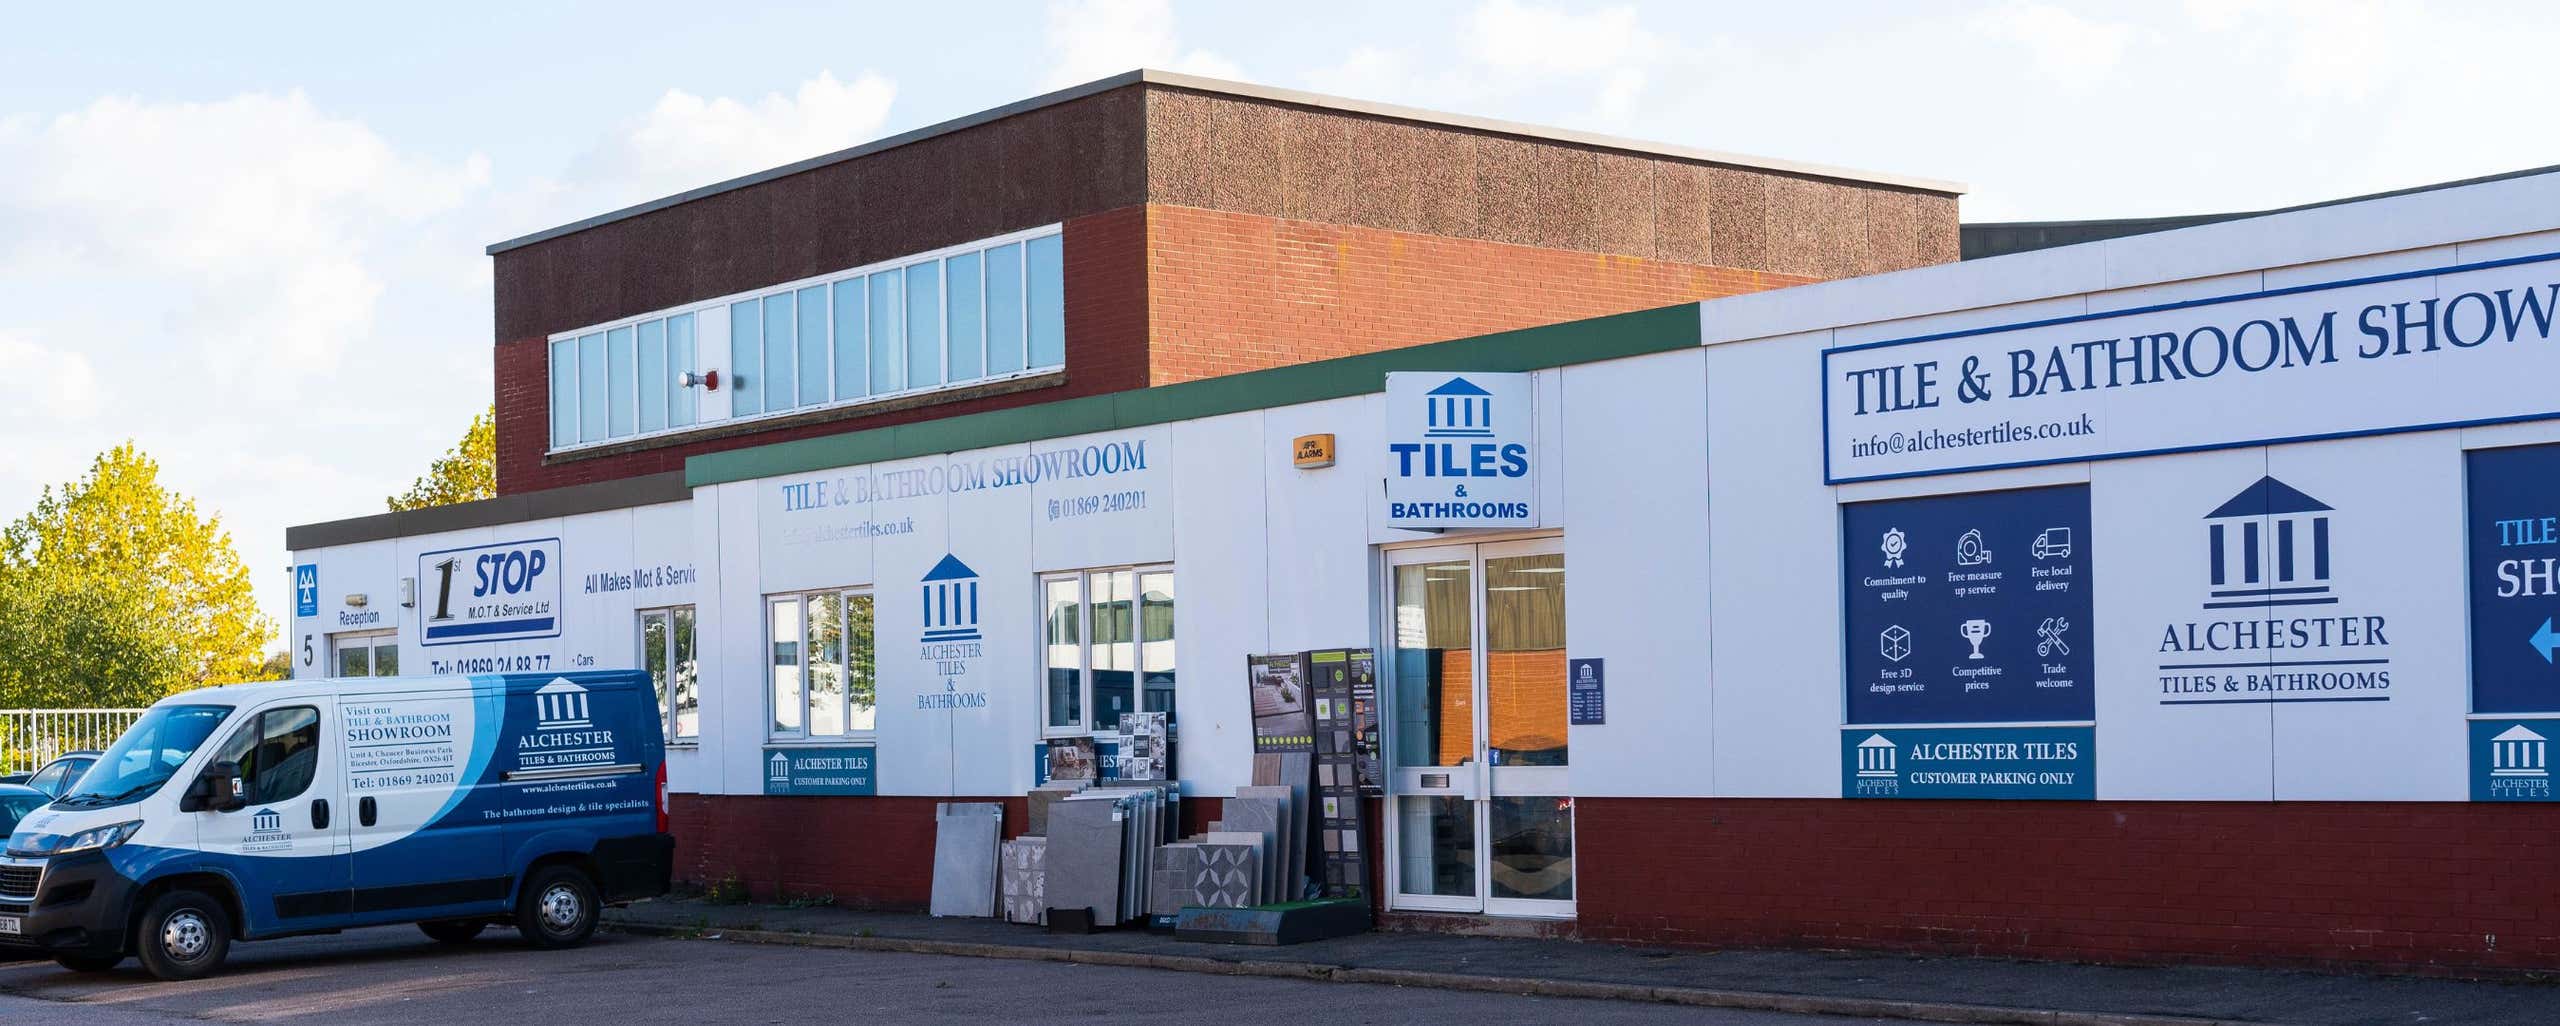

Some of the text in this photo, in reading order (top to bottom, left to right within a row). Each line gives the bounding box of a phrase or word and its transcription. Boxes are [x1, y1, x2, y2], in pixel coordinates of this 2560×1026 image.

[1846, 284, 2560, 417] TILE & BATHROOM SHOW
[1851, 413, 2095, 459] info@alchestertiles.co.uk
[1390, 443, 1528, 478] TILES
[783, 439, 1147, 512] TILE & BATHROOM SHOWROOM
[1454, 484, 1468, 497] &
[1063, 490, 1147, 518] 01869 240201
[1391, 502, 1529, 519] BATHROOMS
[2495, 517, 2557, 546] TILE
[473, 549, 546, 597] STOP
[1948, 572, 2002, 583] Free measure
[2032, 565, 2072, 577] Free local
[2497, 558, 2560, 597] SH
[585, 574, 598, 594] All
[600, 572, 632, 592] Makes
[634, 569, 653, 589] Mot
[656, 566, 663, 587] &
[1864, 575, 1926, 587] Commitment to
[2035, 580, 2070, 593] delivery
[1881, 589, 1909, 602] quality
[1955, 584, 1996, 597] up service
[468, 600, 550, 619] M.O.T & Service Ltd
[340, 609, 380, 628] Reception
[2159, 616, 2389, 653] ALCHESTER
[304, 635, 313, 667] 5
[920, 643, 983, 661] ALCHESTER
[536, 654, 551, 670] 77
[577, 653, 594, 666] Cars
[937, 660, 965, 677] TILES
[1881, 668, 1912, 679] Free 3D
[1952, 666, 2002, 679] Competitive
[2042, 663, 2066, 674] Trade
[947, 678, 956, 692] &
[1870, 682, 1925, 694] design service
[1965, 680, 1989, 692] prices
[2035, 678, 2073, 688] welcome
[2159, 671, 2390, 694] TILES & BATHROOMS
[917, 692, 986, 710] BATHROOMS
[346, 706, 391, 715] Visit our
[347, 714, 450, 727] TILE & BATHROOM
[348, 724, 451, 741] SHOWROOM
[518, 730, 613, 749] ALCHESTER
[1910, 742, 2078, 760] ALCHESTER TILES
[519, 752, 615, 765] TILES & BATHROOMS
[794, 757, 868, 770] ALCHESTER TILES
[352, 772, 454, 789] Tel: 01869 240201
[794, 777, 866, 786] CUSTOMER PARKING ONLY
[1856, 779, 1898, 788] ALCHESTER
[1910, 772, 2075, 785] CUSTOMER PARKING ONLY
[2490, 779, 2549, 789] ALCHESTER
[522, 780, 617, 793] www.alchestertiles.co.uk
[2491, 789, 2549, 797] TILES
[484, 800, 649, 819] The bathroom design & tile specialists
